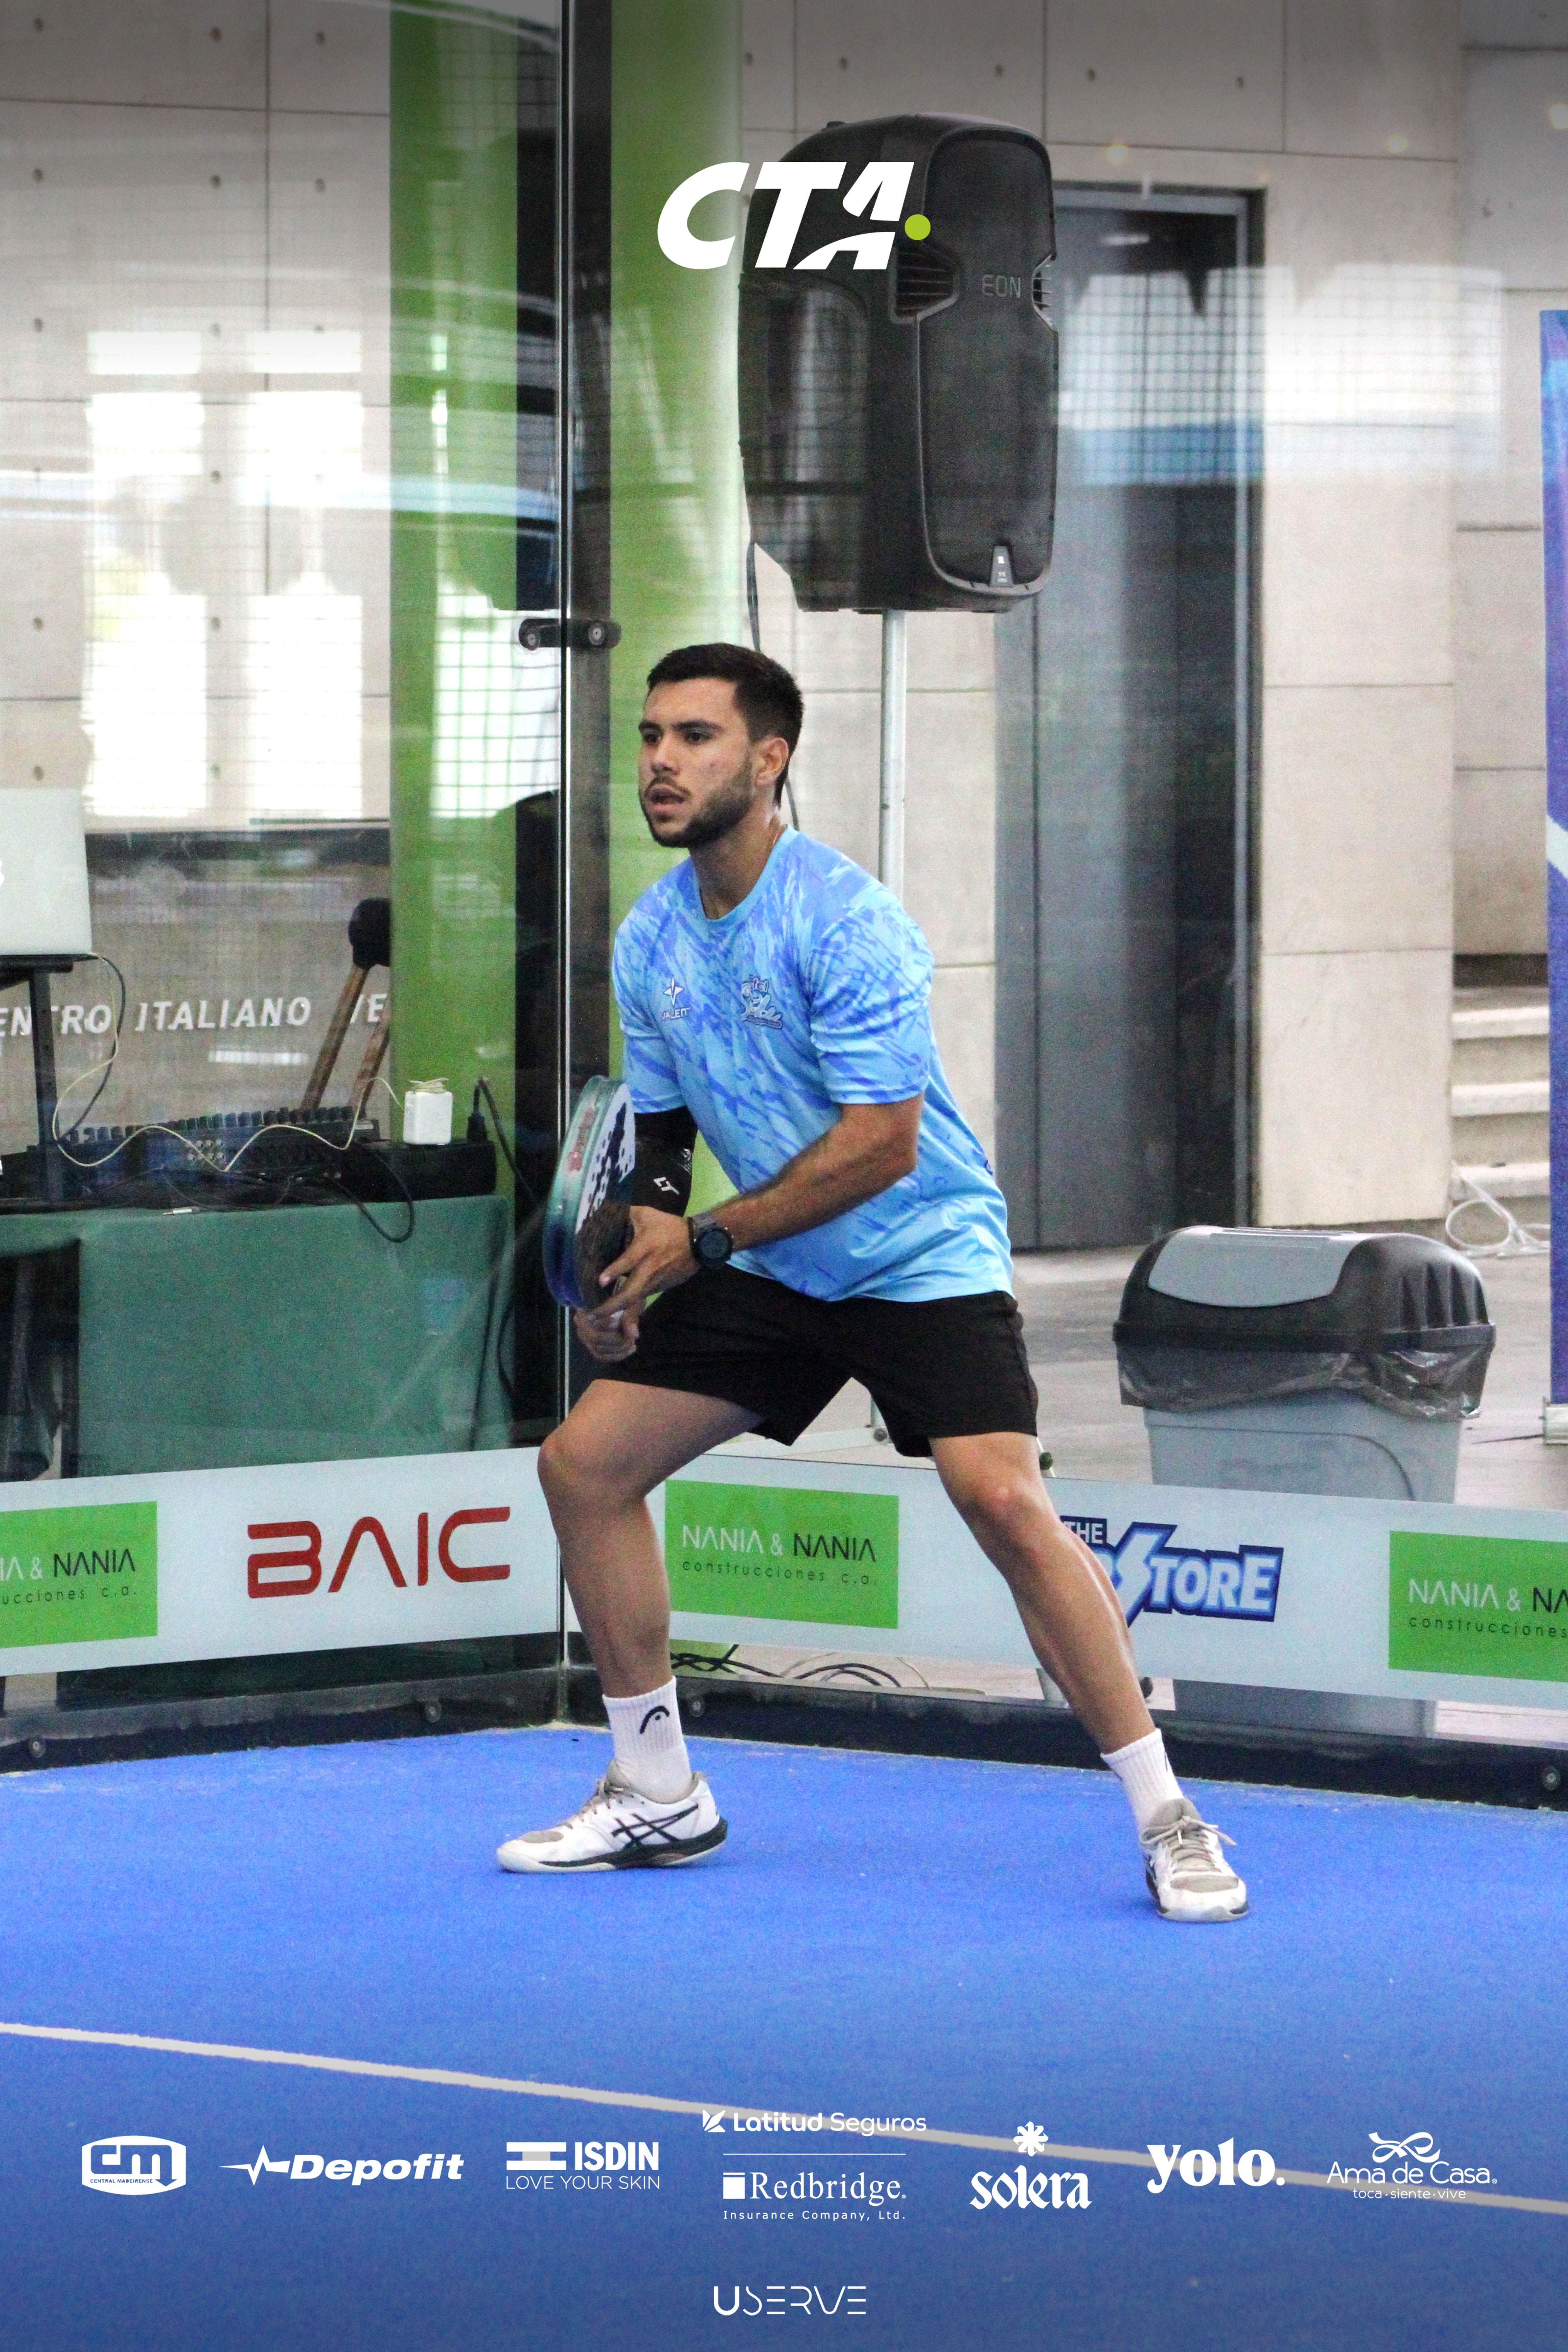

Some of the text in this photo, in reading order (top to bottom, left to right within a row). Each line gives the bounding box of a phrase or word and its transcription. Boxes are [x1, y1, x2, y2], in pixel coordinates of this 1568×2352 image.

[982, 274, 1021, 298] EON
[135, 996, 311, 1031] ITALIANO
[248, 1506, 510, 1599] BAIC
[682, 1525, 876, 1562] NANIA & NANIA
[30, 1557, 43, 1580] &
[54, 1548, 136, 1577] NANIA
[682, 1560, 824, 1582] construcciones
[1409, 1578, 1499, 1608] NANIA
[1506, 1587, 1521, 1612] &
[1409, 1617, 1566, 1638] construcciones
